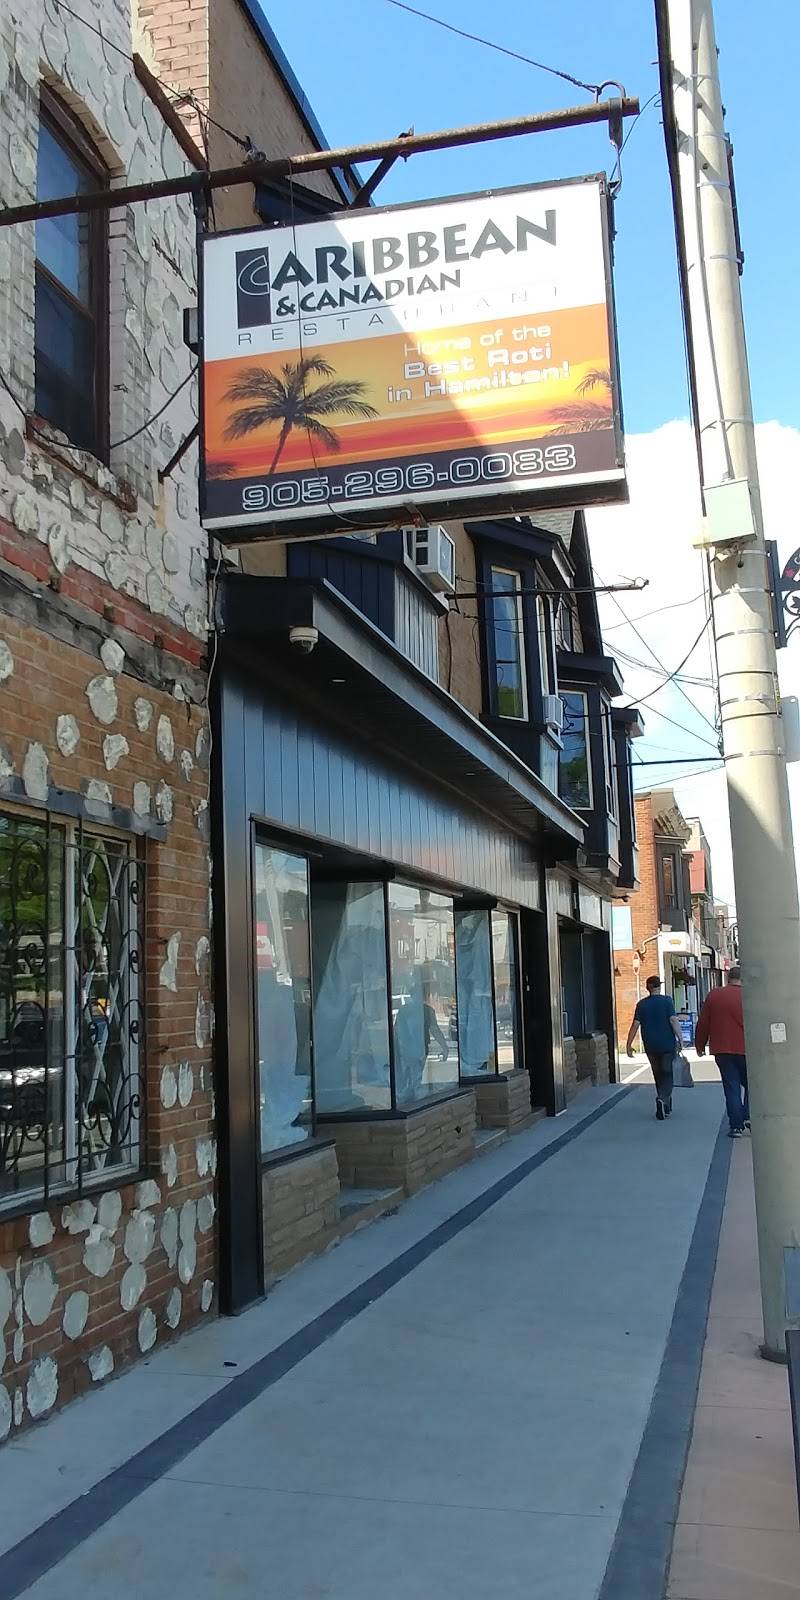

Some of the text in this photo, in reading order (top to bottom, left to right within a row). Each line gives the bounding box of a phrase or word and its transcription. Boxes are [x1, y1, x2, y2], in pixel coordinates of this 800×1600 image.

[236, 209, 557, 296] CARIBBEAN
[403, 342, 552, 380] Best Roti
[404, 324, 551, 357] Home of the
[387, 360, 570, 403] in Hamilton!
[241, 443, 577, 511] 905-296-0083
